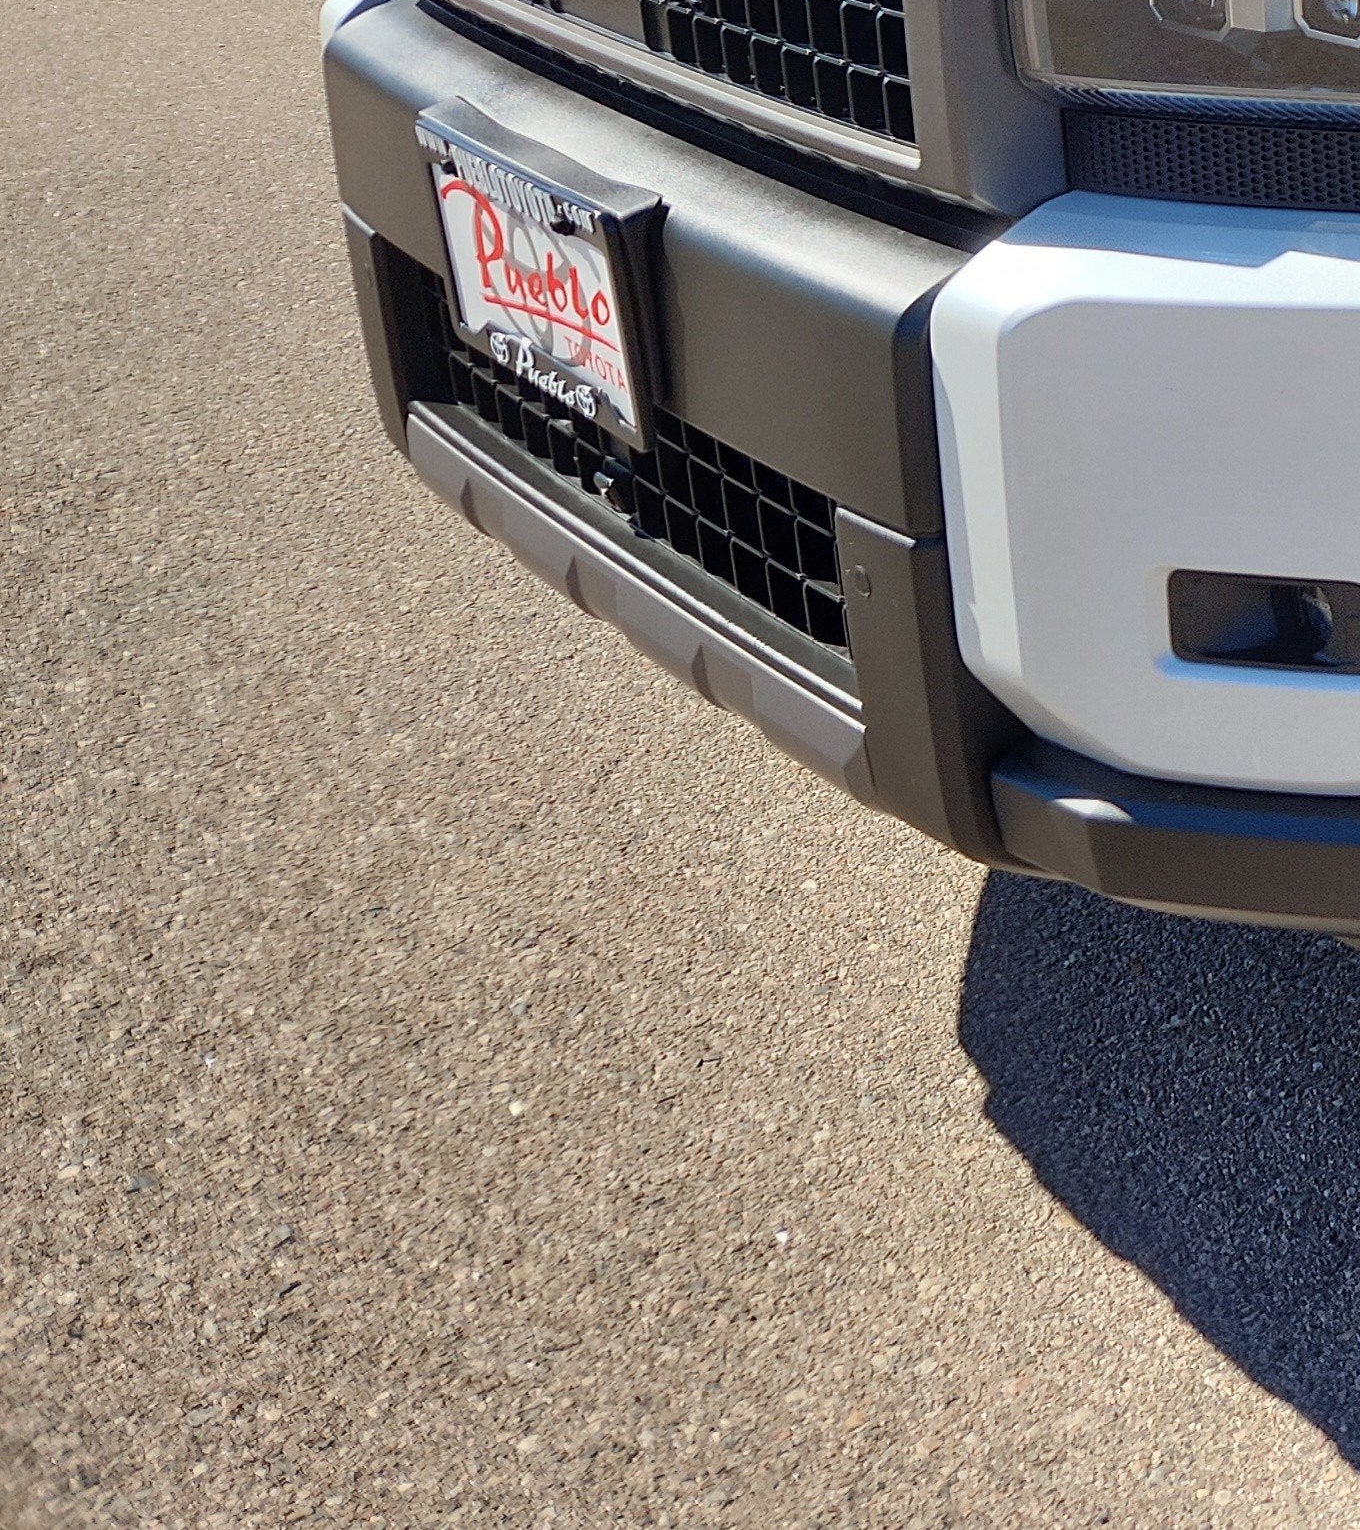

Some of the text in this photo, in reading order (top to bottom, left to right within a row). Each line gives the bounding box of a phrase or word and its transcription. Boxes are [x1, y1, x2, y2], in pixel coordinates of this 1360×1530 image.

[441, 179, 610, 326] Pueblo
[504, 334, 577, 404] Pueblo
[564, 335, 628, 392] TOYOTA
